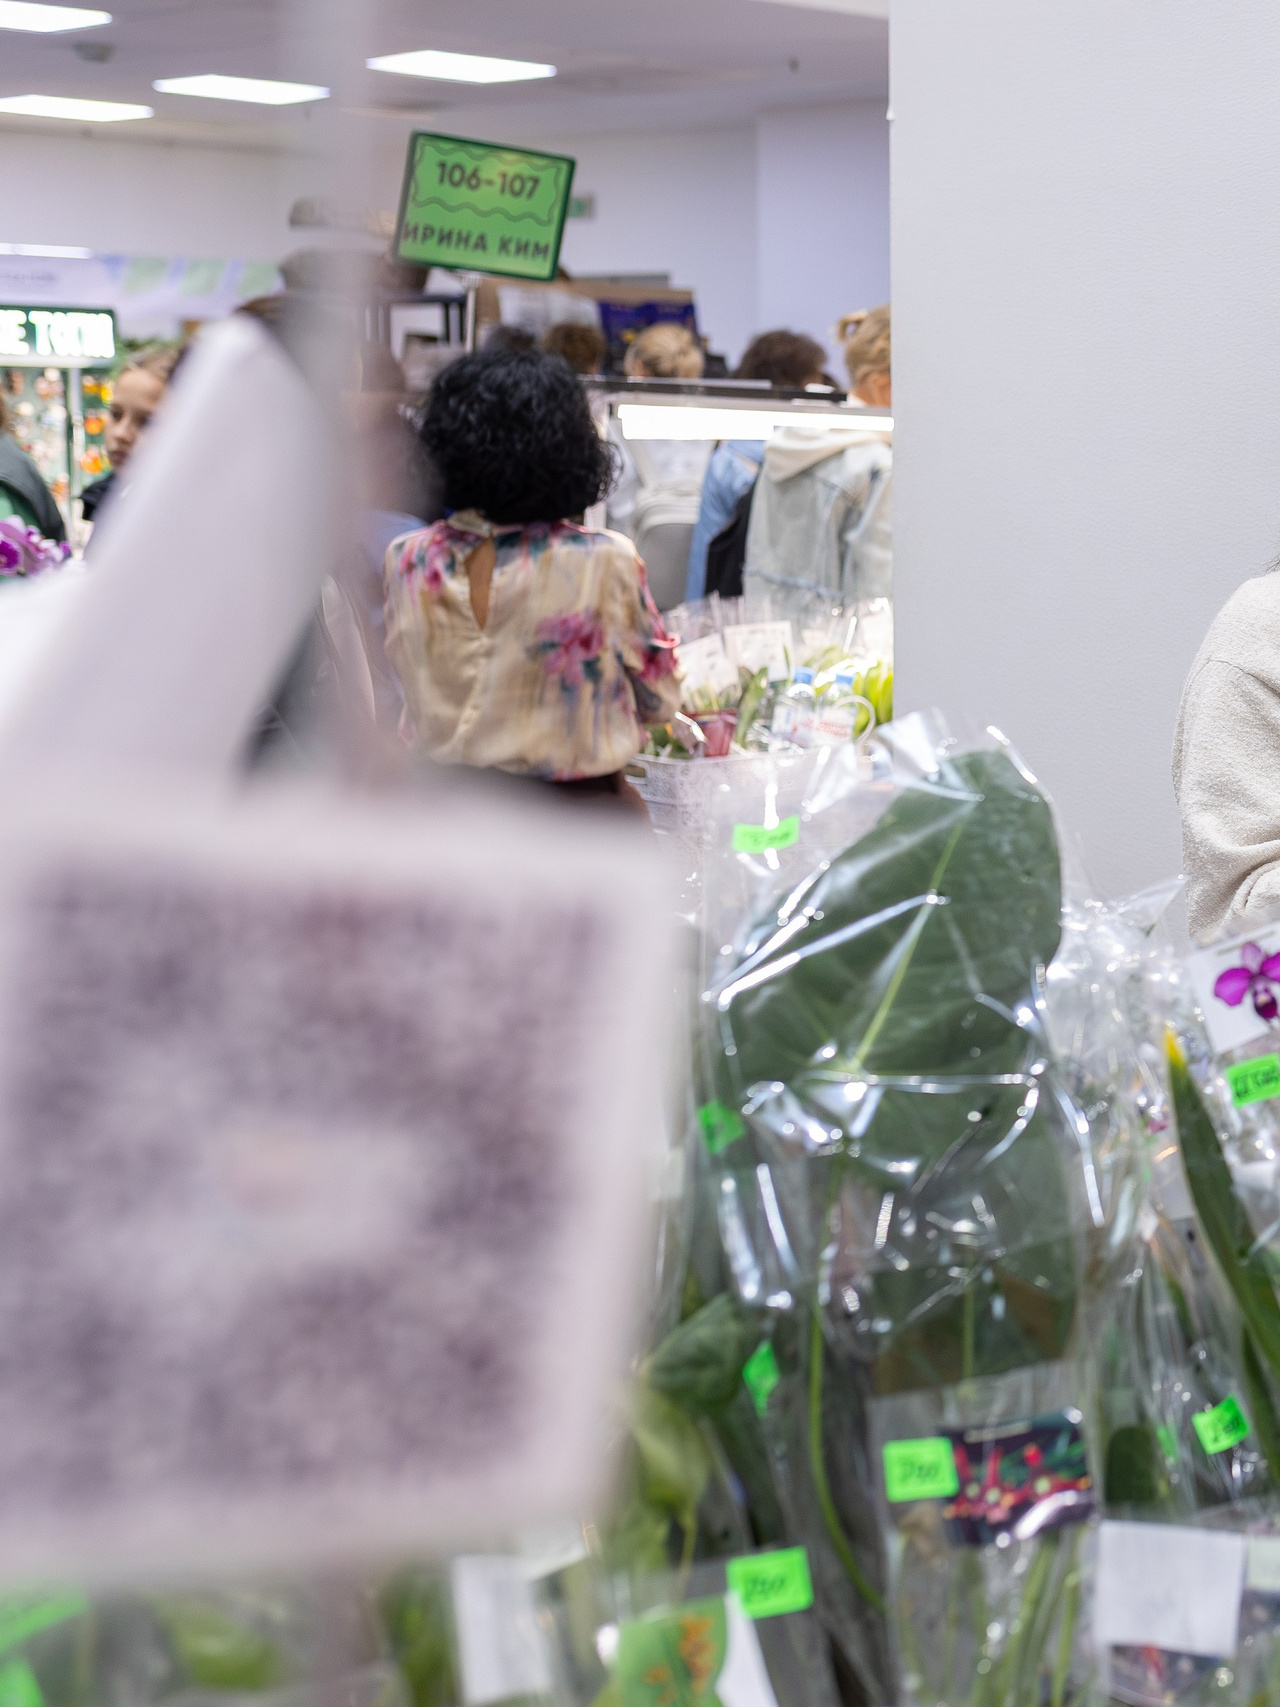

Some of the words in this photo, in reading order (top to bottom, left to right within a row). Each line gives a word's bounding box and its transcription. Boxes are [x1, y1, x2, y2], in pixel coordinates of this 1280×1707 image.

[436, 160, 541, 199] 106-107
[402, 221, 488, 253] ИРИНА
[498, 236, 551, 262] КИМ
